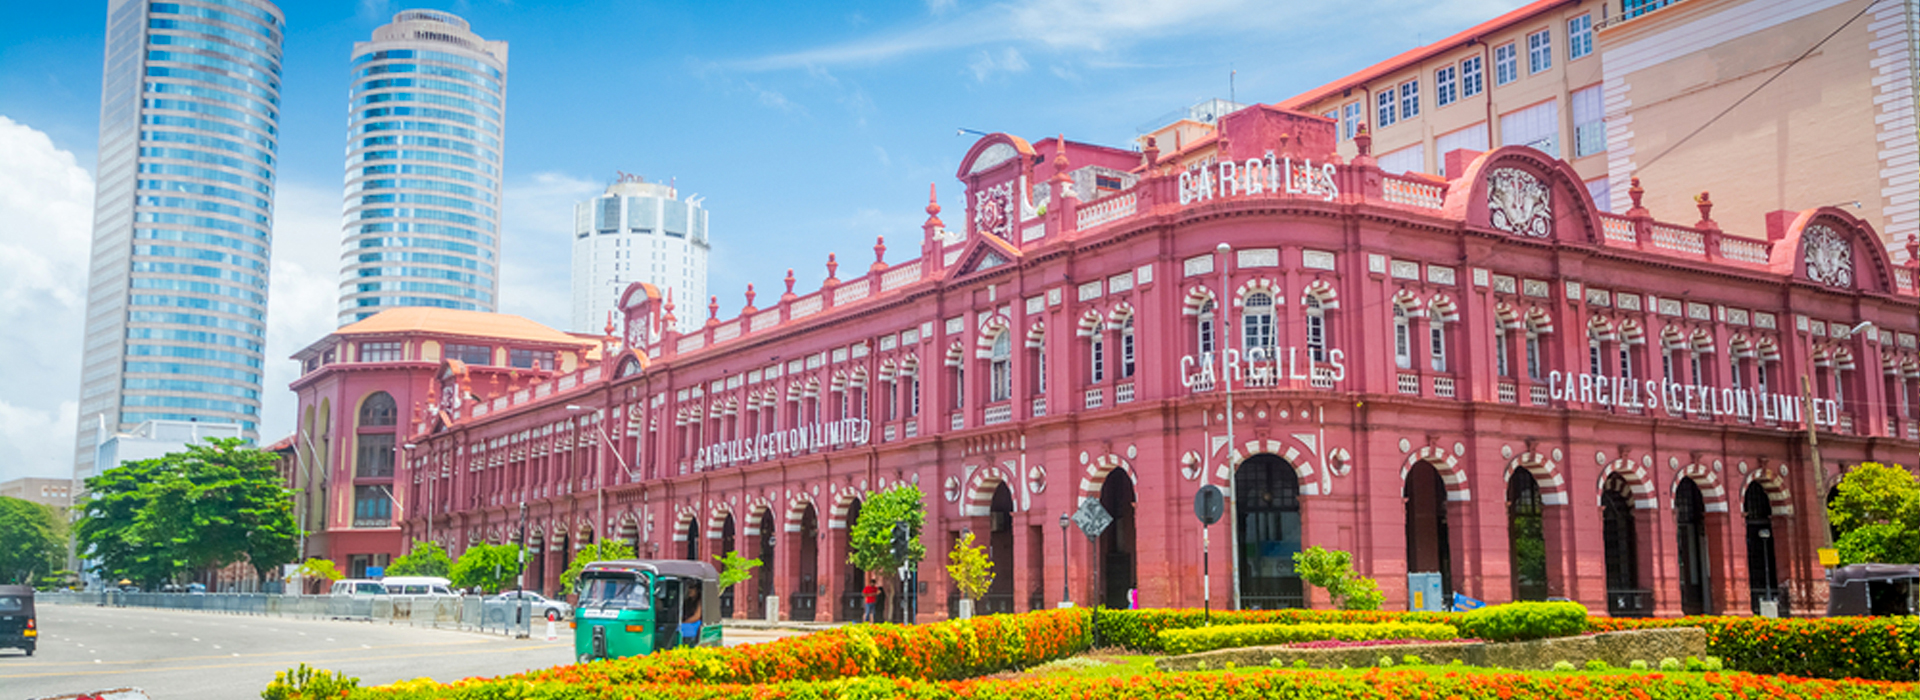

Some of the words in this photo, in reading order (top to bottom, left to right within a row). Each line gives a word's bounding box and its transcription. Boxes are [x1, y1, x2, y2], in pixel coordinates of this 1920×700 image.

[1179, 157, 1339, 205] CARGILLS
[1180, 346, 1345, 387] CARGILLS
[1549, 370, 1658, 409] CARGILLS
[1661, 376, 1758, 422] (CEYLON)
[1762, 391, 1838, 426] LIMIED
[698, 438, 752, 469] CARGILLS
[816, 417, 871, 447] LIMITED
